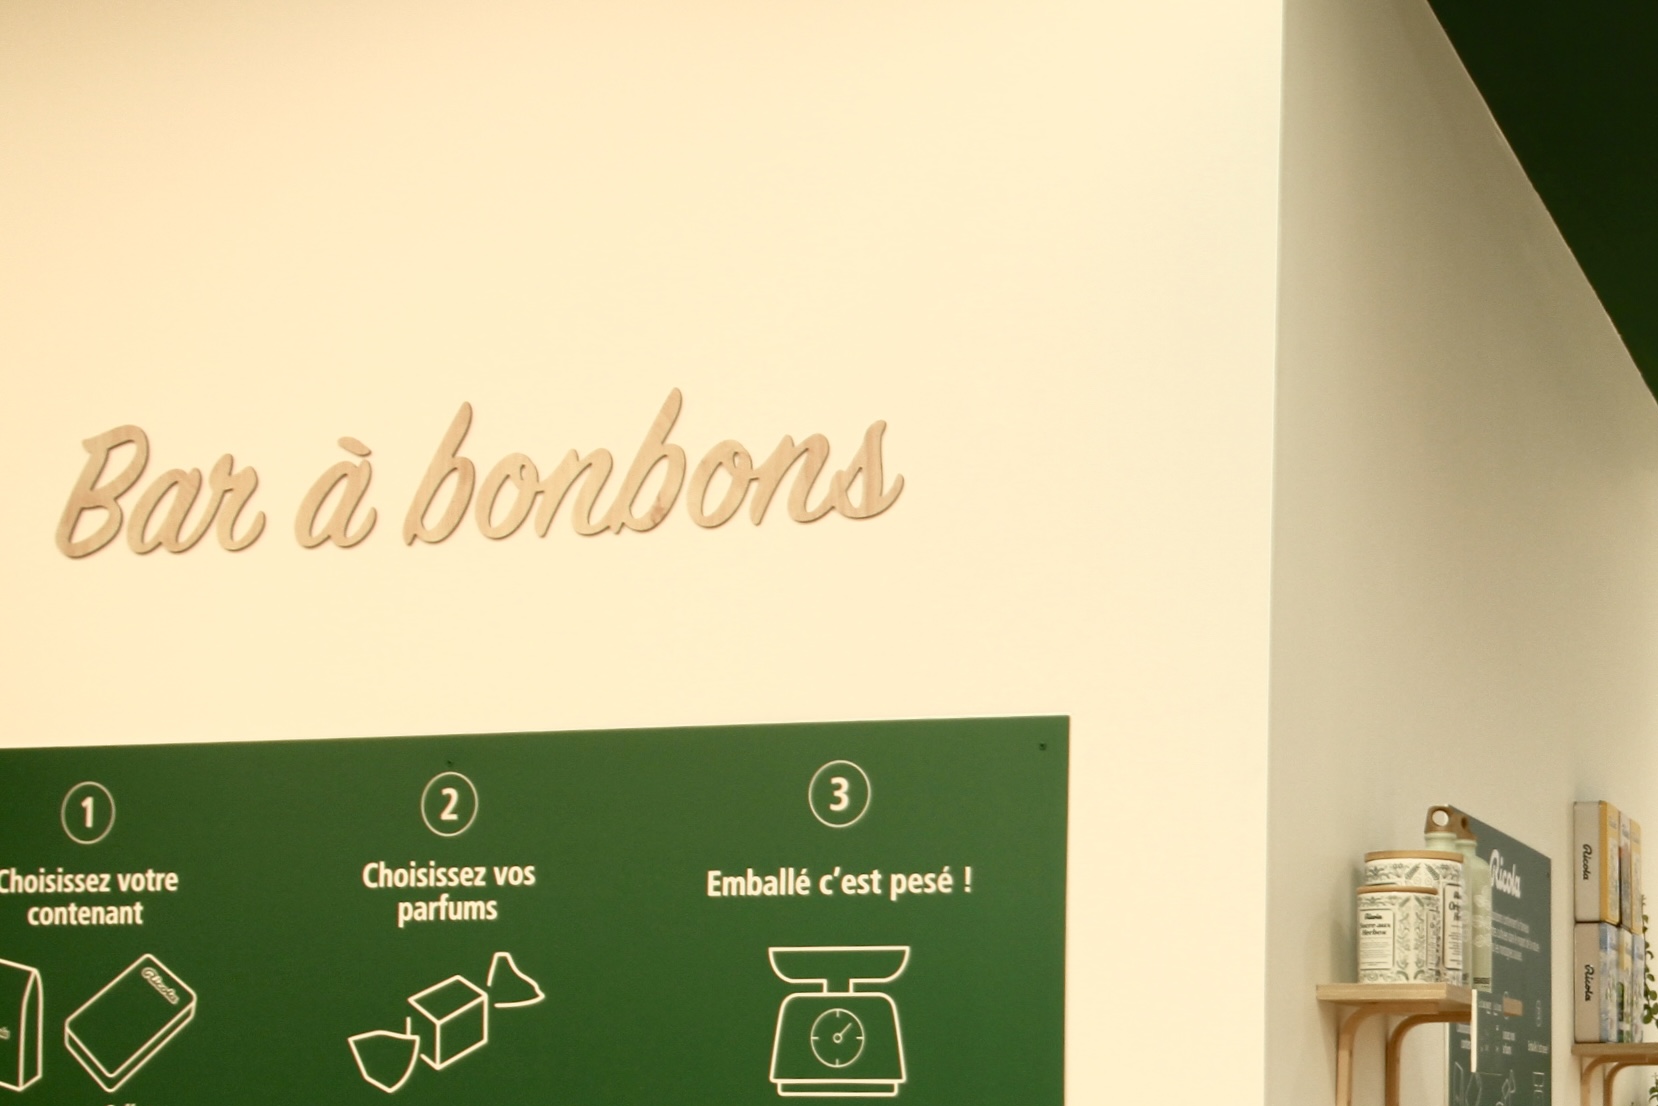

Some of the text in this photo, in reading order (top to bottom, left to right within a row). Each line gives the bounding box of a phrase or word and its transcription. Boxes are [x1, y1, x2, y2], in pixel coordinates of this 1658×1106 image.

[55, 387, 905, 560] Bar à bonbons
[81, 796, 94, 828] 1
[440, 787, 459, 821] 2
[829, 776, 850, 812] 3
[362, 860, 536, 889] Choisissez vos
[1489, 848, 1522, 900] Ricola
[1582, 843, 1593, 881] Ricola
[0, 867, 179, 894] Choisissez votre
[707, 867, 811, 897] Emballé
[890, 865, 953, 902] pesé
[964, 866, 973, 894] !
[27, 901, 144, 926] contenant
[397, 893, 498, 929] parfums
[1584, 964, 1595, 1002] Ricola
